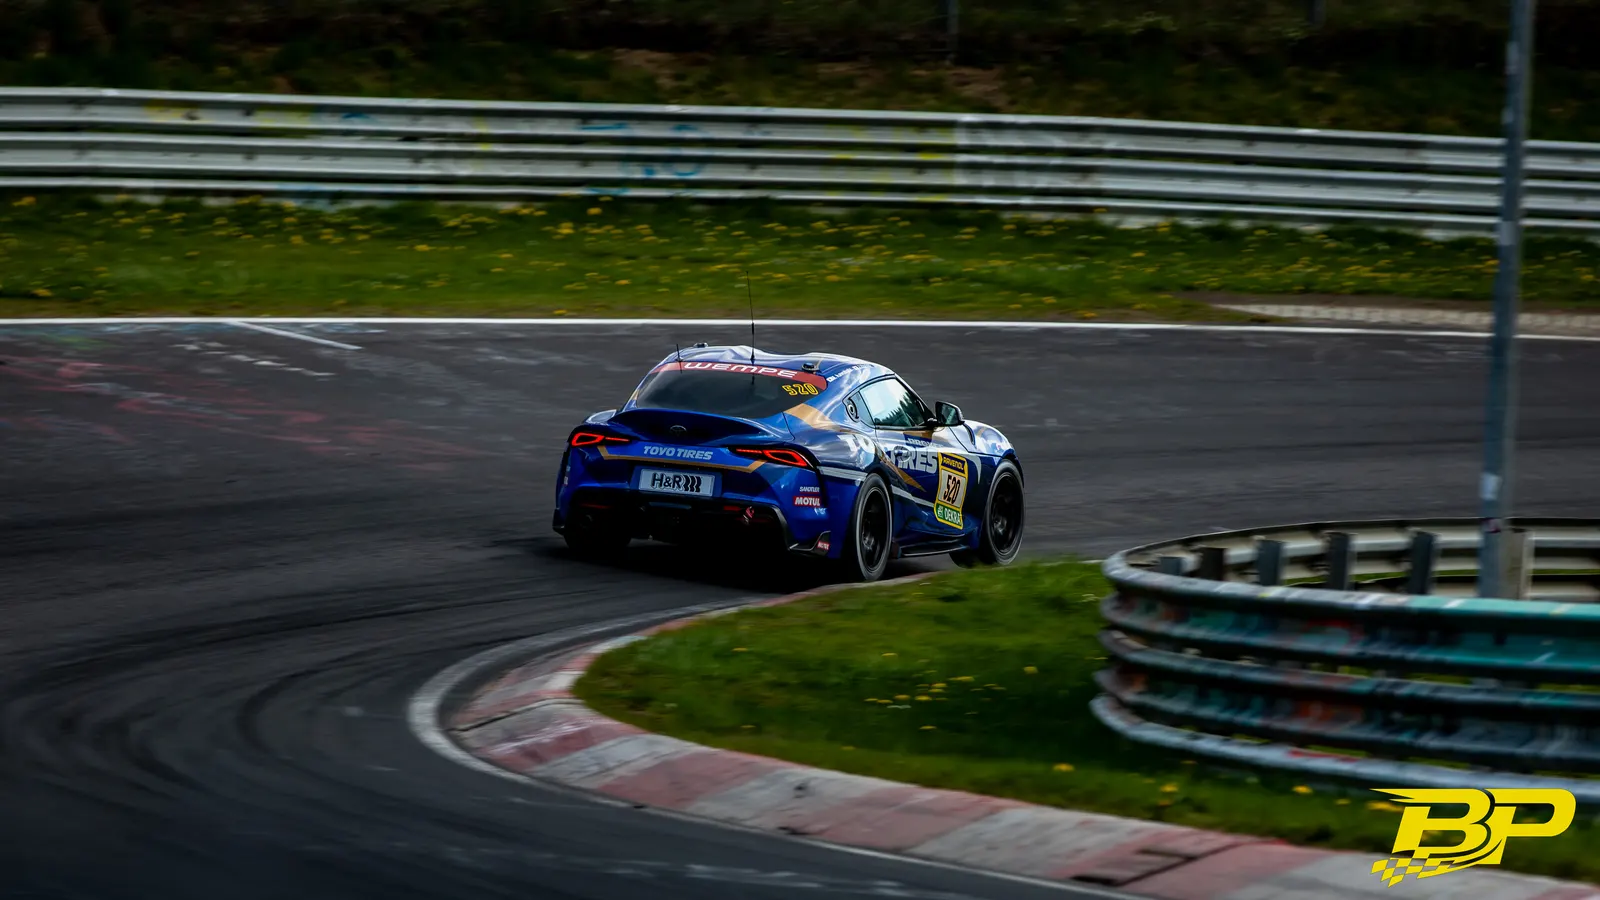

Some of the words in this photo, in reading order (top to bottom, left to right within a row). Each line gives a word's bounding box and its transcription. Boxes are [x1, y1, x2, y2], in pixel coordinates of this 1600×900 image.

[684, 362, 798, 379] WEMPE
[782, 383, 819, 396] 520
[643, 445, 676, 457] TOYO
[676, 448, 714, 460] TIRES
[651, 472, 684, 490] H&R
[943, 474, 961, 505] 520
[795, 497, 821, 506] MOTUL
[944, 507, 962, 524] DEKRA
